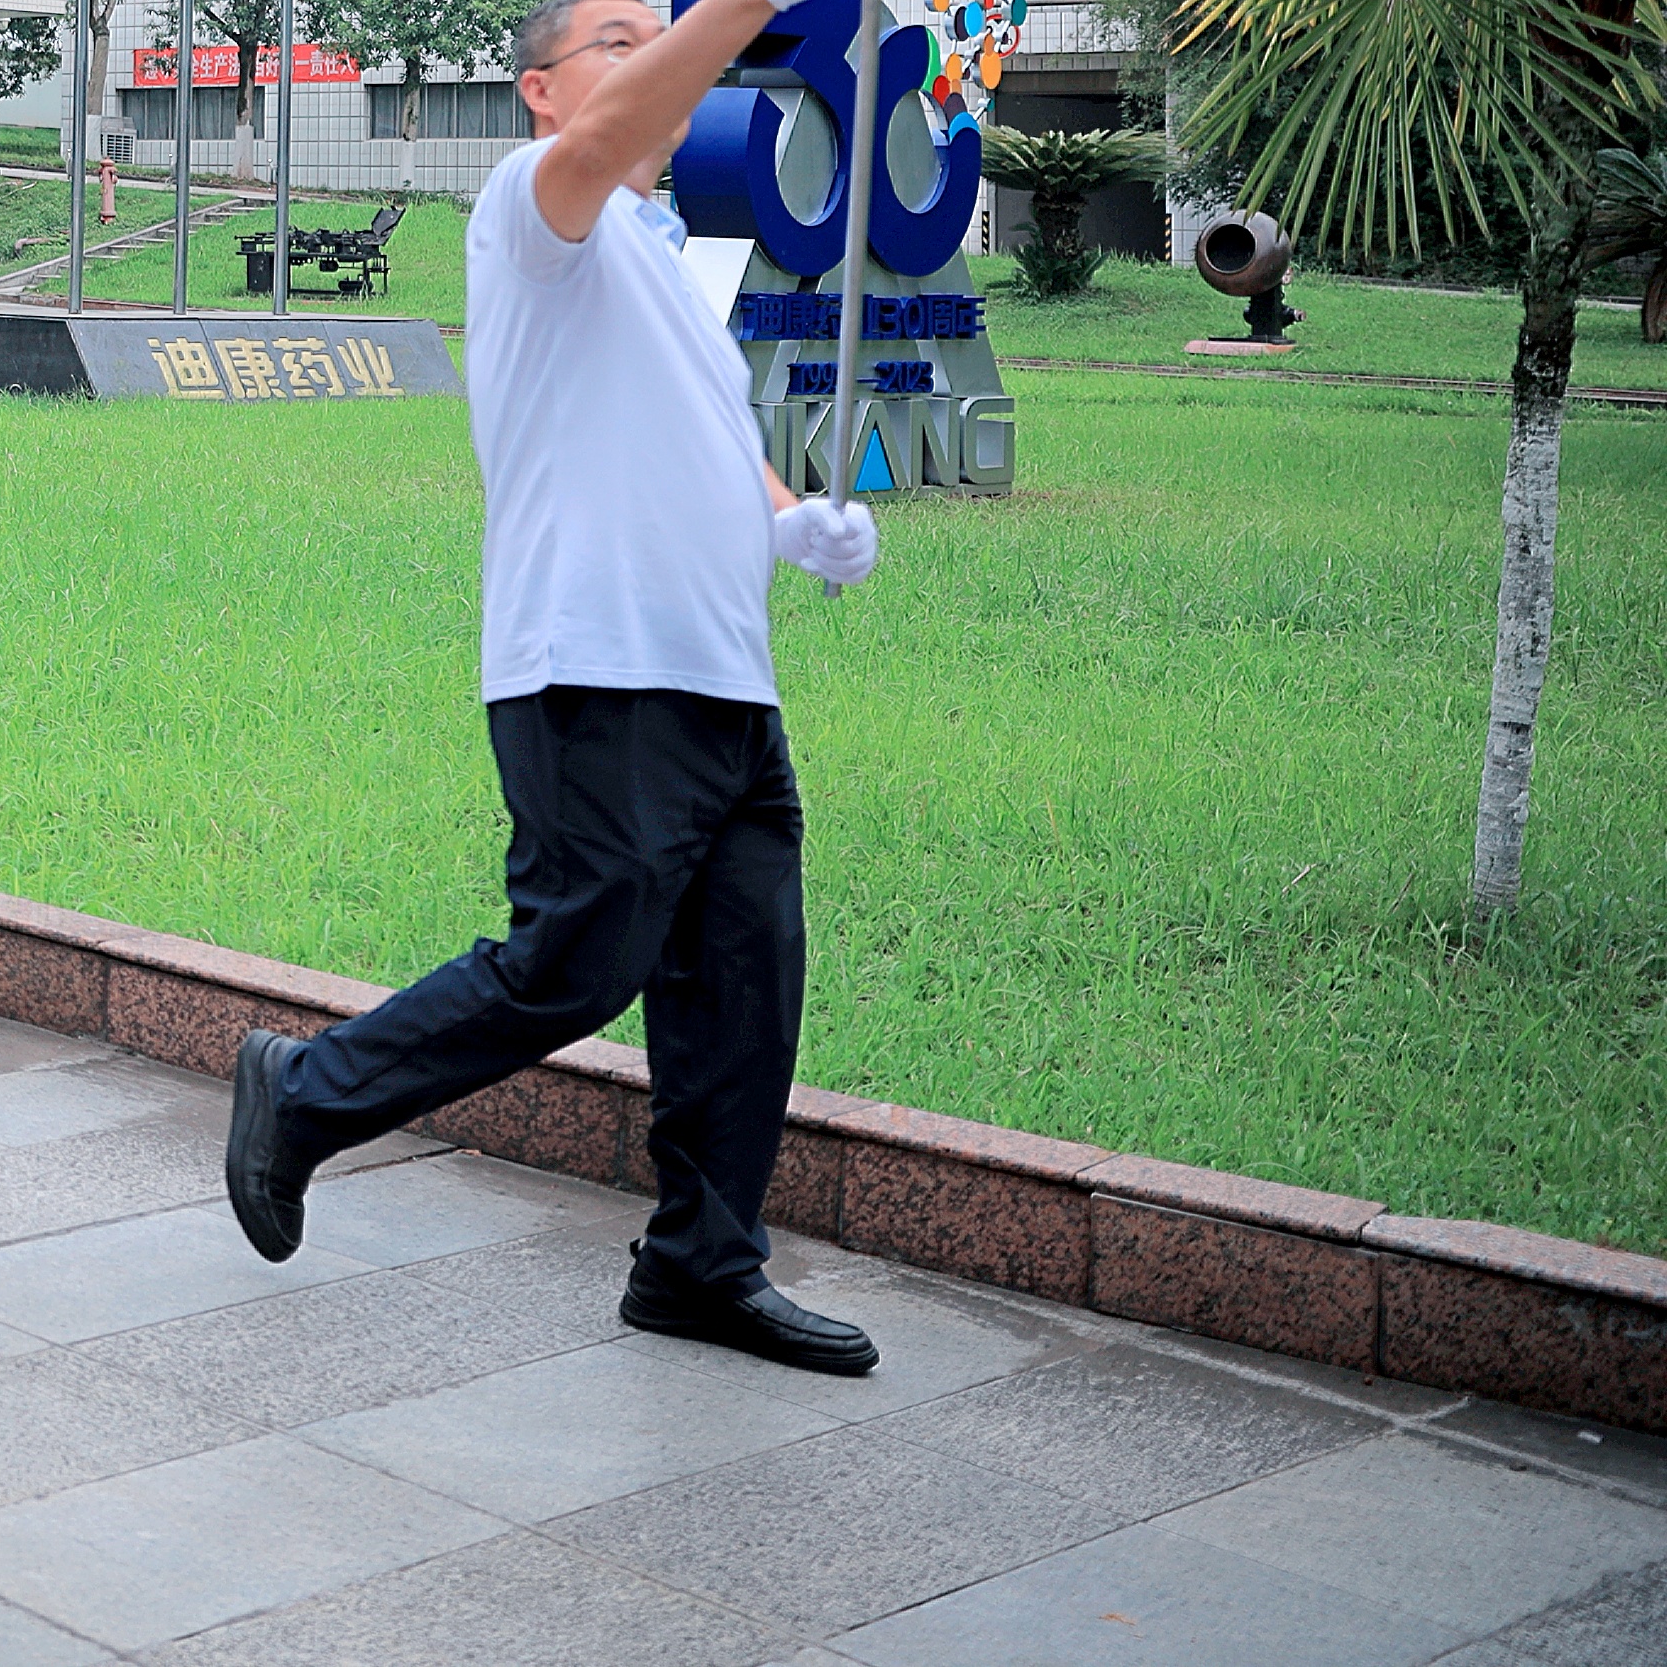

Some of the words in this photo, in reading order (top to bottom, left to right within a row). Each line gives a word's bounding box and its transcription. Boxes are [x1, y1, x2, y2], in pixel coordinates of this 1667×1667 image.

[147, 337, 406, 399] 迪康药业
[787, 361, 935, 395] 199—2023
[753, 397, 1015, 494] IKANG
